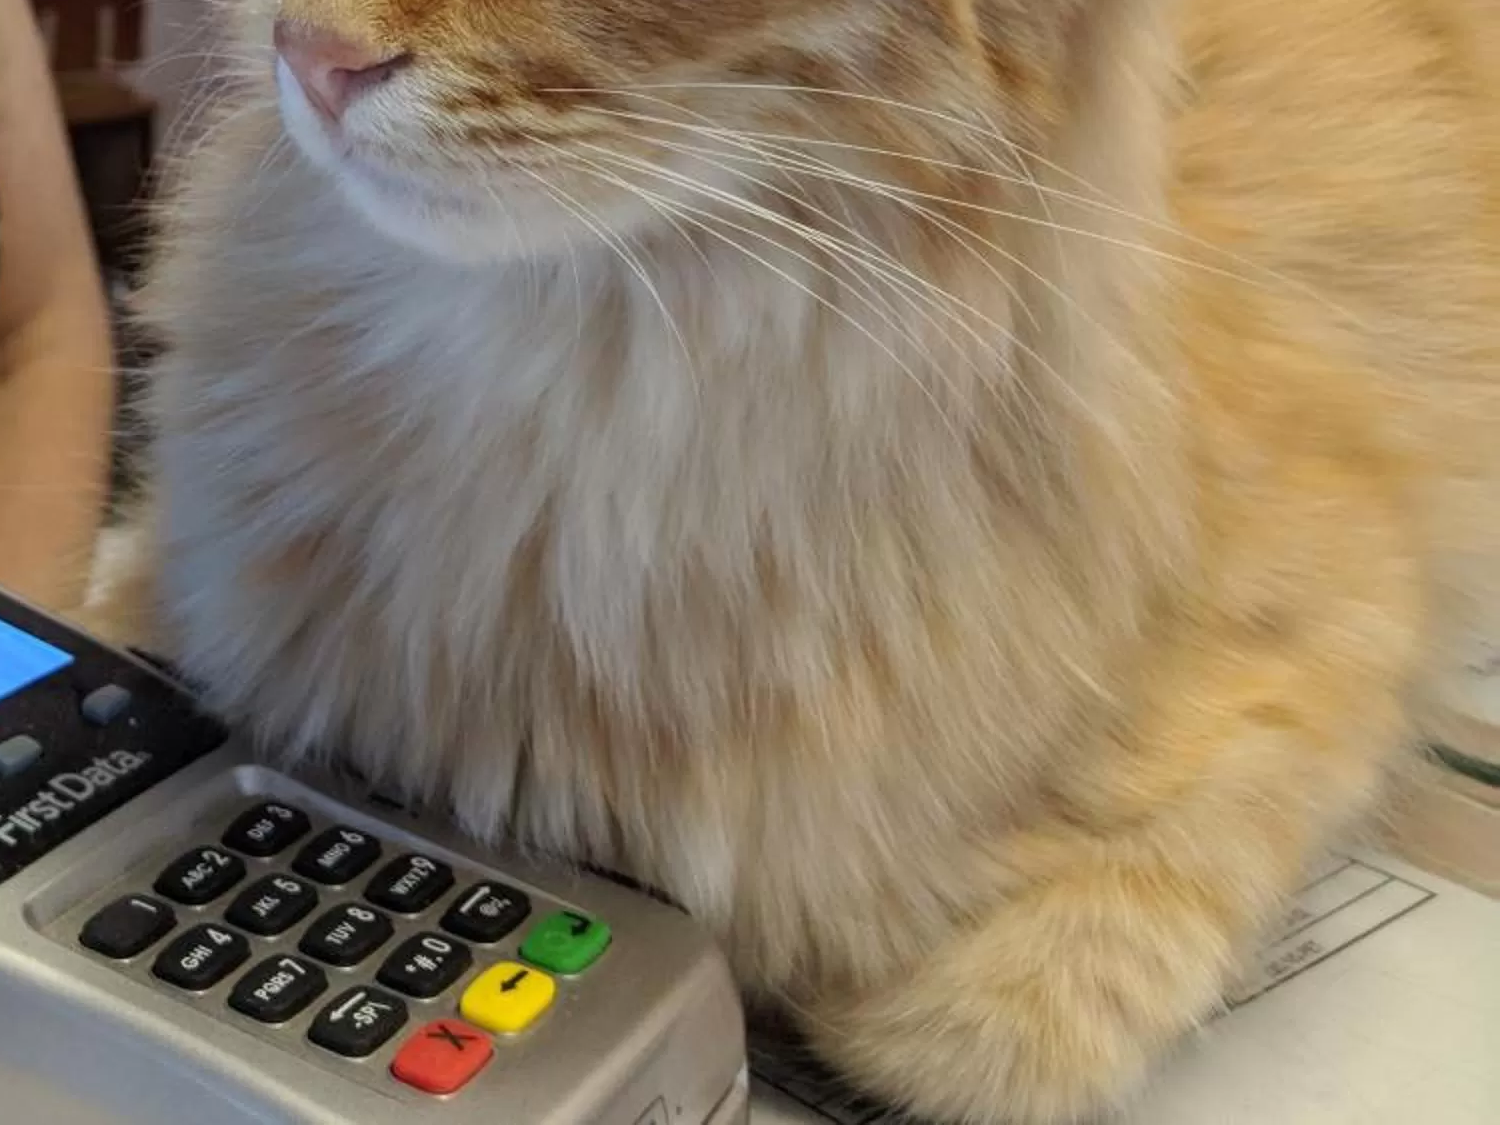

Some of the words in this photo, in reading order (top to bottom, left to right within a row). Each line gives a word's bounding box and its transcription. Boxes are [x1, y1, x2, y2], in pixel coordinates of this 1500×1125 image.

[201, 849, 230, 867] 2
[346, 906, 375, 922] 8
[180, 943, 213, 971] GHI
[206, 927, 233, 945] 4
[278, 957, 306, 975] 7
